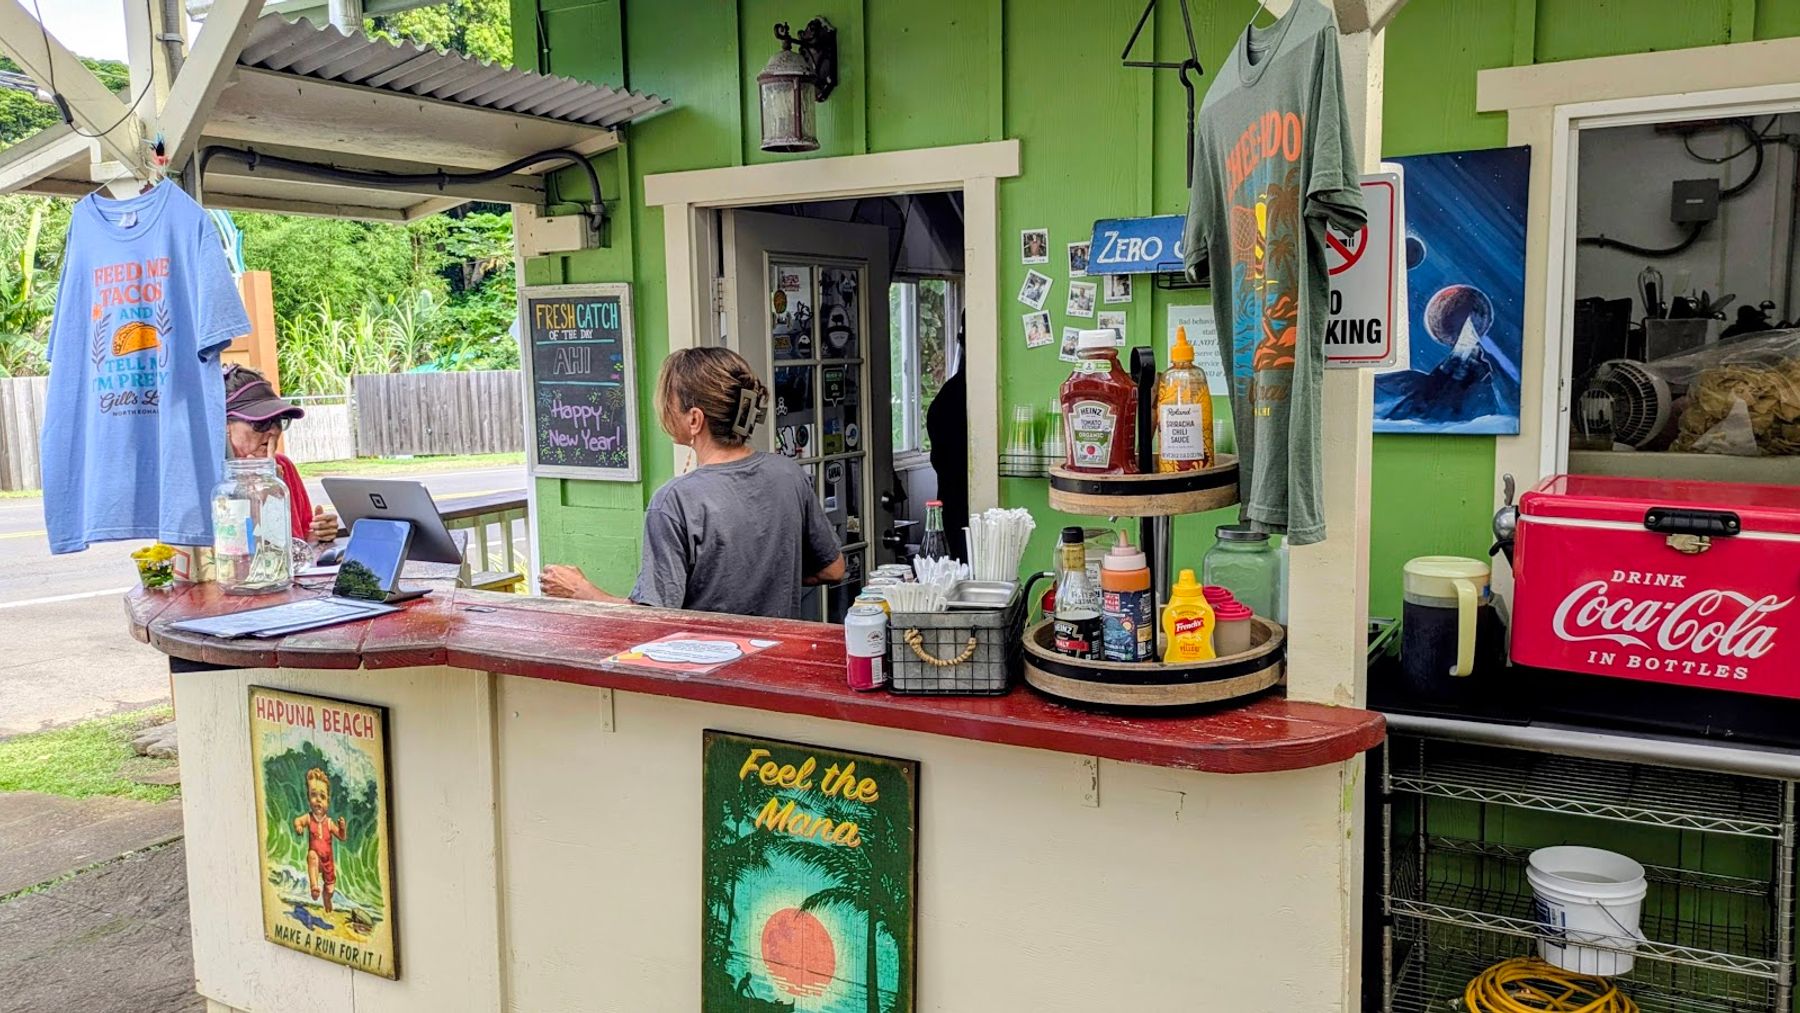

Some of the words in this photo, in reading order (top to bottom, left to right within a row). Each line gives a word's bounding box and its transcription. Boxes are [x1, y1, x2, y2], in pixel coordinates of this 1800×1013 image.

[1096, 230, 1163, 264] ZERO
[94, 262, 143, 288] FEED
[146, 256, 170, 279] ME
[120, 306, 153, 320] AND
[535, 303, 576, 330] FRESH
[576, 302, 618, 330] CATCH
[1329, 289, 1343, 316] O
[549, 330, 559, 341] OF
[561, 329, 578, 340] THE
[580, 329, 594, 340] DAY
[1324, 318, 1382, 345] KING
[104, 356, 146, 373] TELL
[553, 346, 592, 376] AHI
[100, 390, 138, 415] Gill's
[550, 399, 603, 432] Happy
[1080, 407, 1103, 417] HEINZ
[549, 428, 579, 448] New
[581, 425, 621, 451] Year!
[1170, 436, 1190, 444] SAUCE
[1171, 428, 1188, 436] CHILI
[1610, 570, 1687, 588] DRINK
[1552, 580, 1796, 659] Coca-Cola
[1587, 650, 1617, 666] IN
[1626, 655, 1749, 680] BOTTLES
[255, 695, 316, 730] HAPUNA
[321, 707, 375, 739] BEACH
[739, 748, 817, 791] Feel
[820, 760, 880, 803] the
[755, 796, 862, 848] Mana
[274, 923, 301, 945] MAKE
[304, 933, 312, 949] A
[315, 934, 336, 955] RUN
[339, 943, 359, 963] FOR
